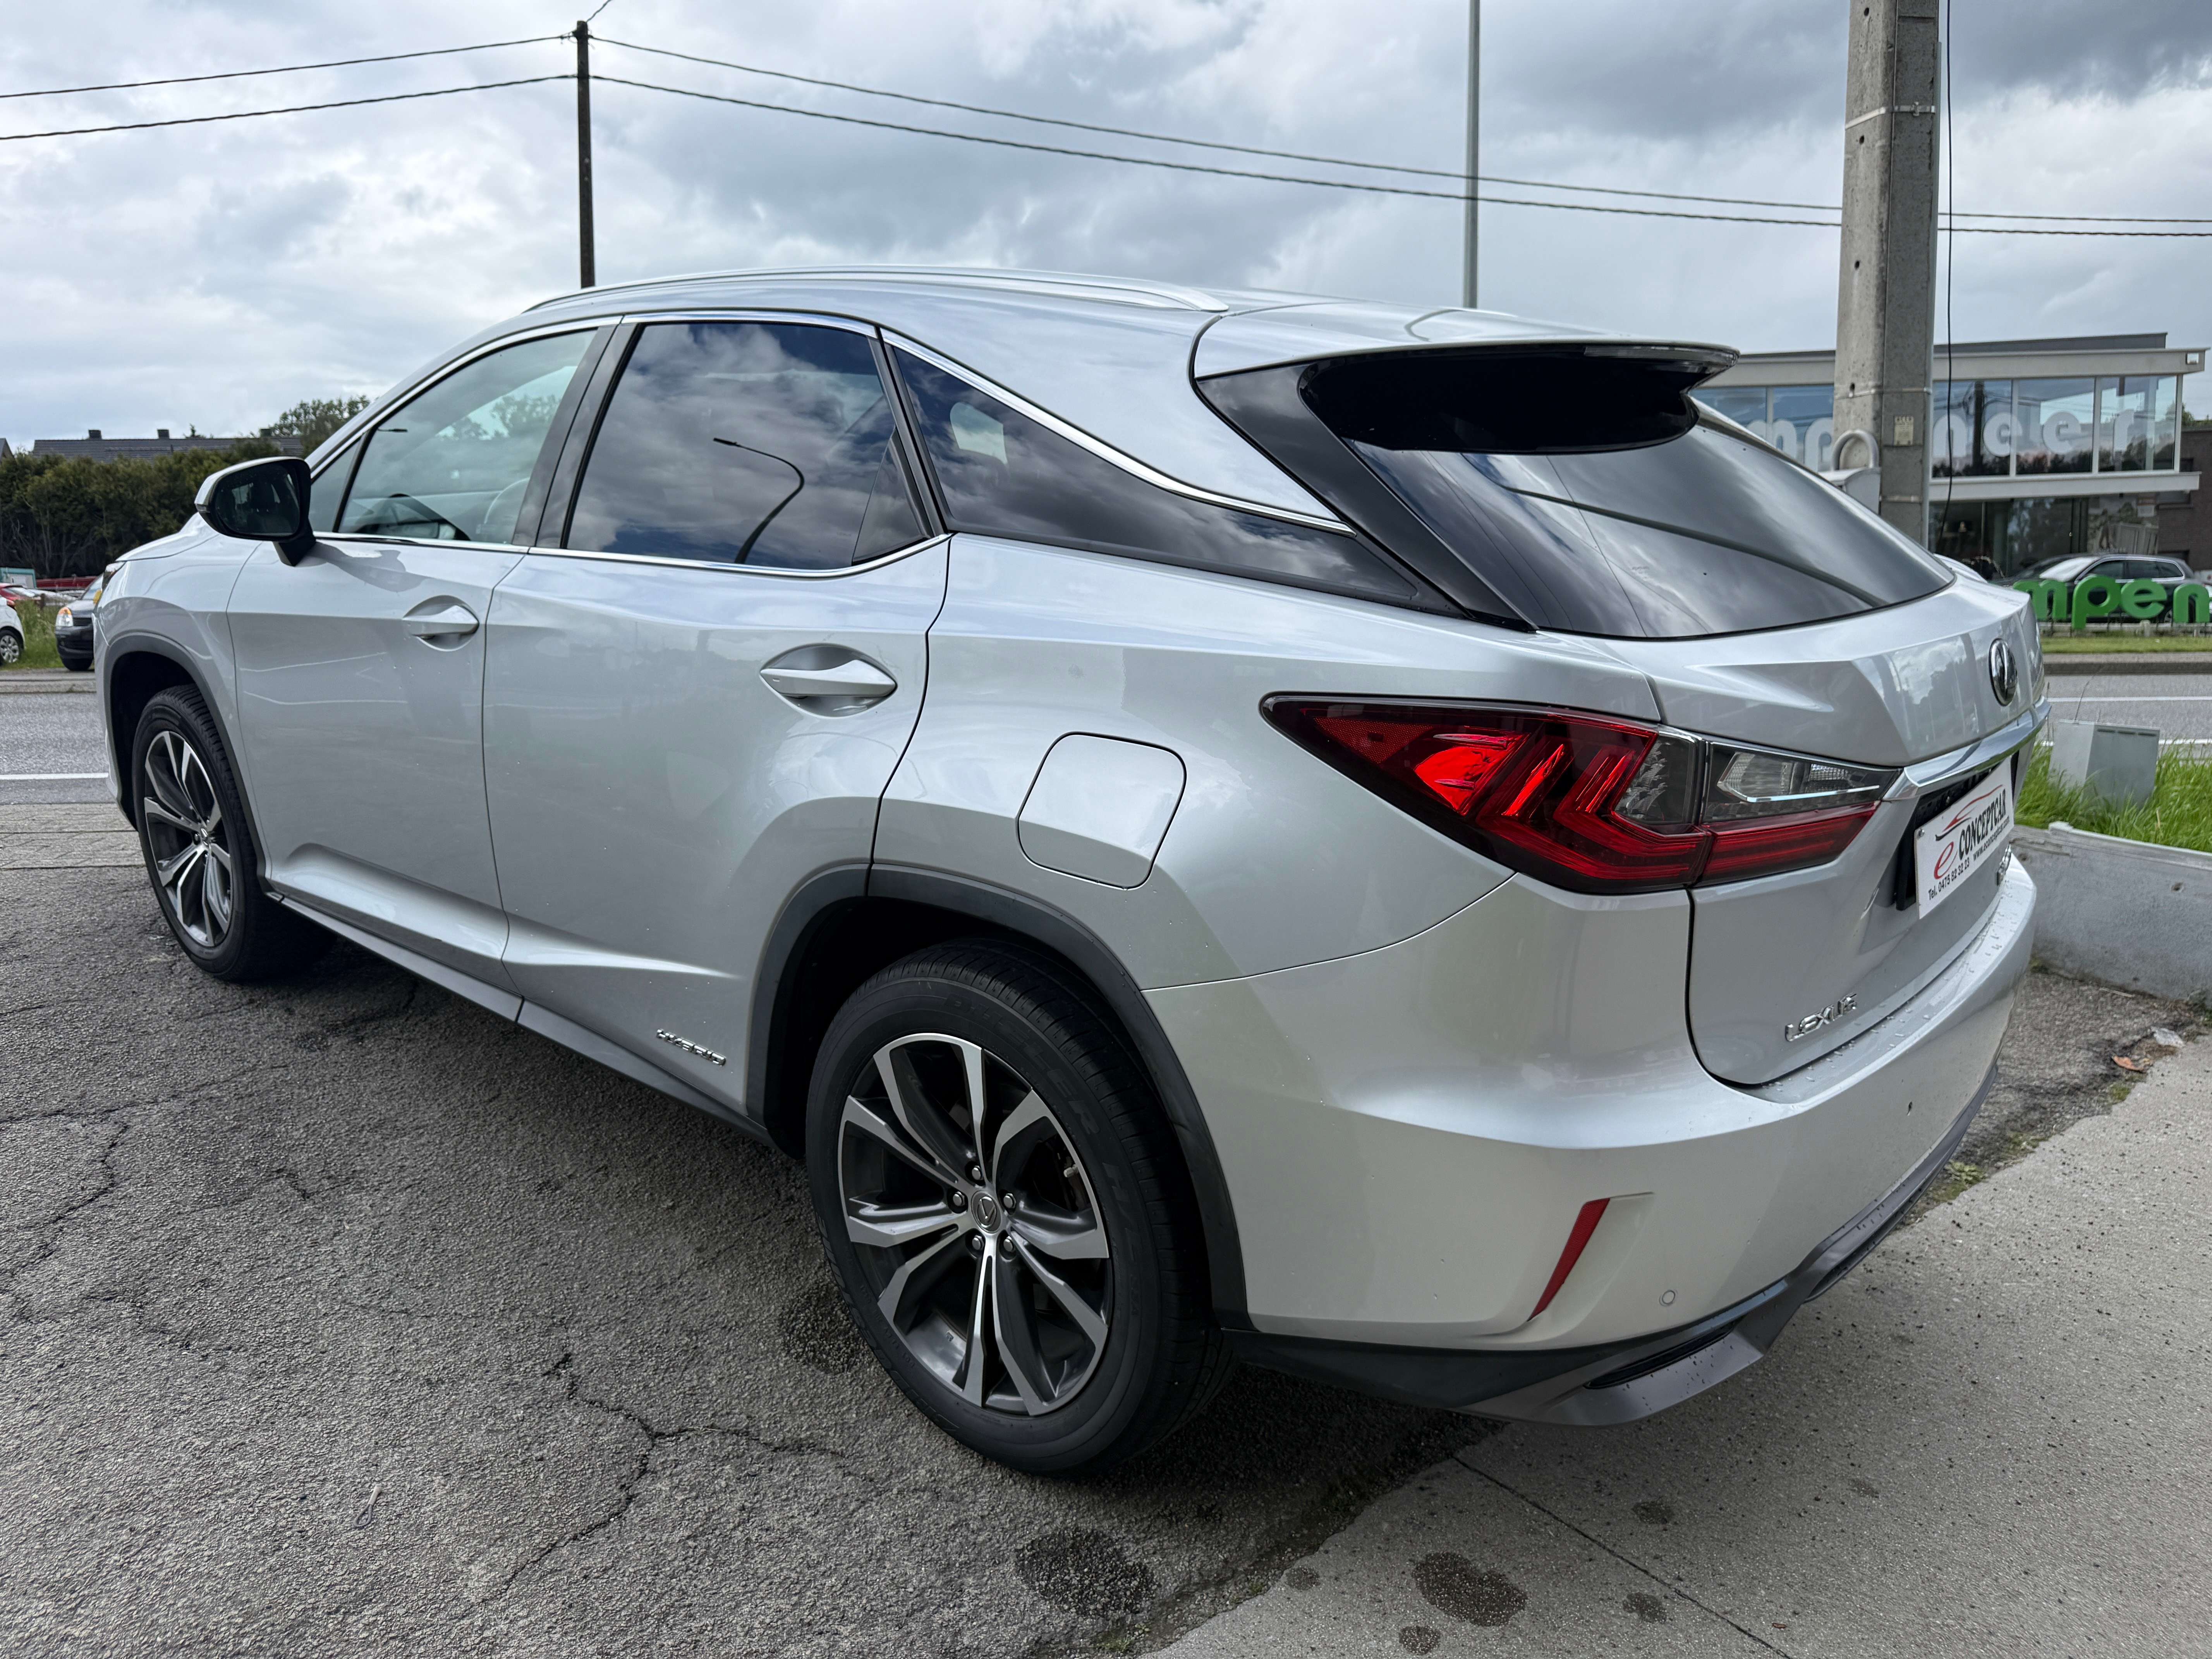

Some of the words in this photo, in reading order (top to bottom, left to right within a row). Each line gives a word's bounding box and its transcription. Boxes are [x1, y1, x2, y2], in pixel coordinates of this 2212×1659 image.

[1959, 788, 2006, 861] CONCEPTCAR
[1928, 888, 1937, 901] Tel.
[1938, 876, 1950, 892] 0475
[1958, 863, 1964, 875] 32
[1965, 857, 1970, 871] 23
[1785, 993, 1857, 1042] LEXUS
